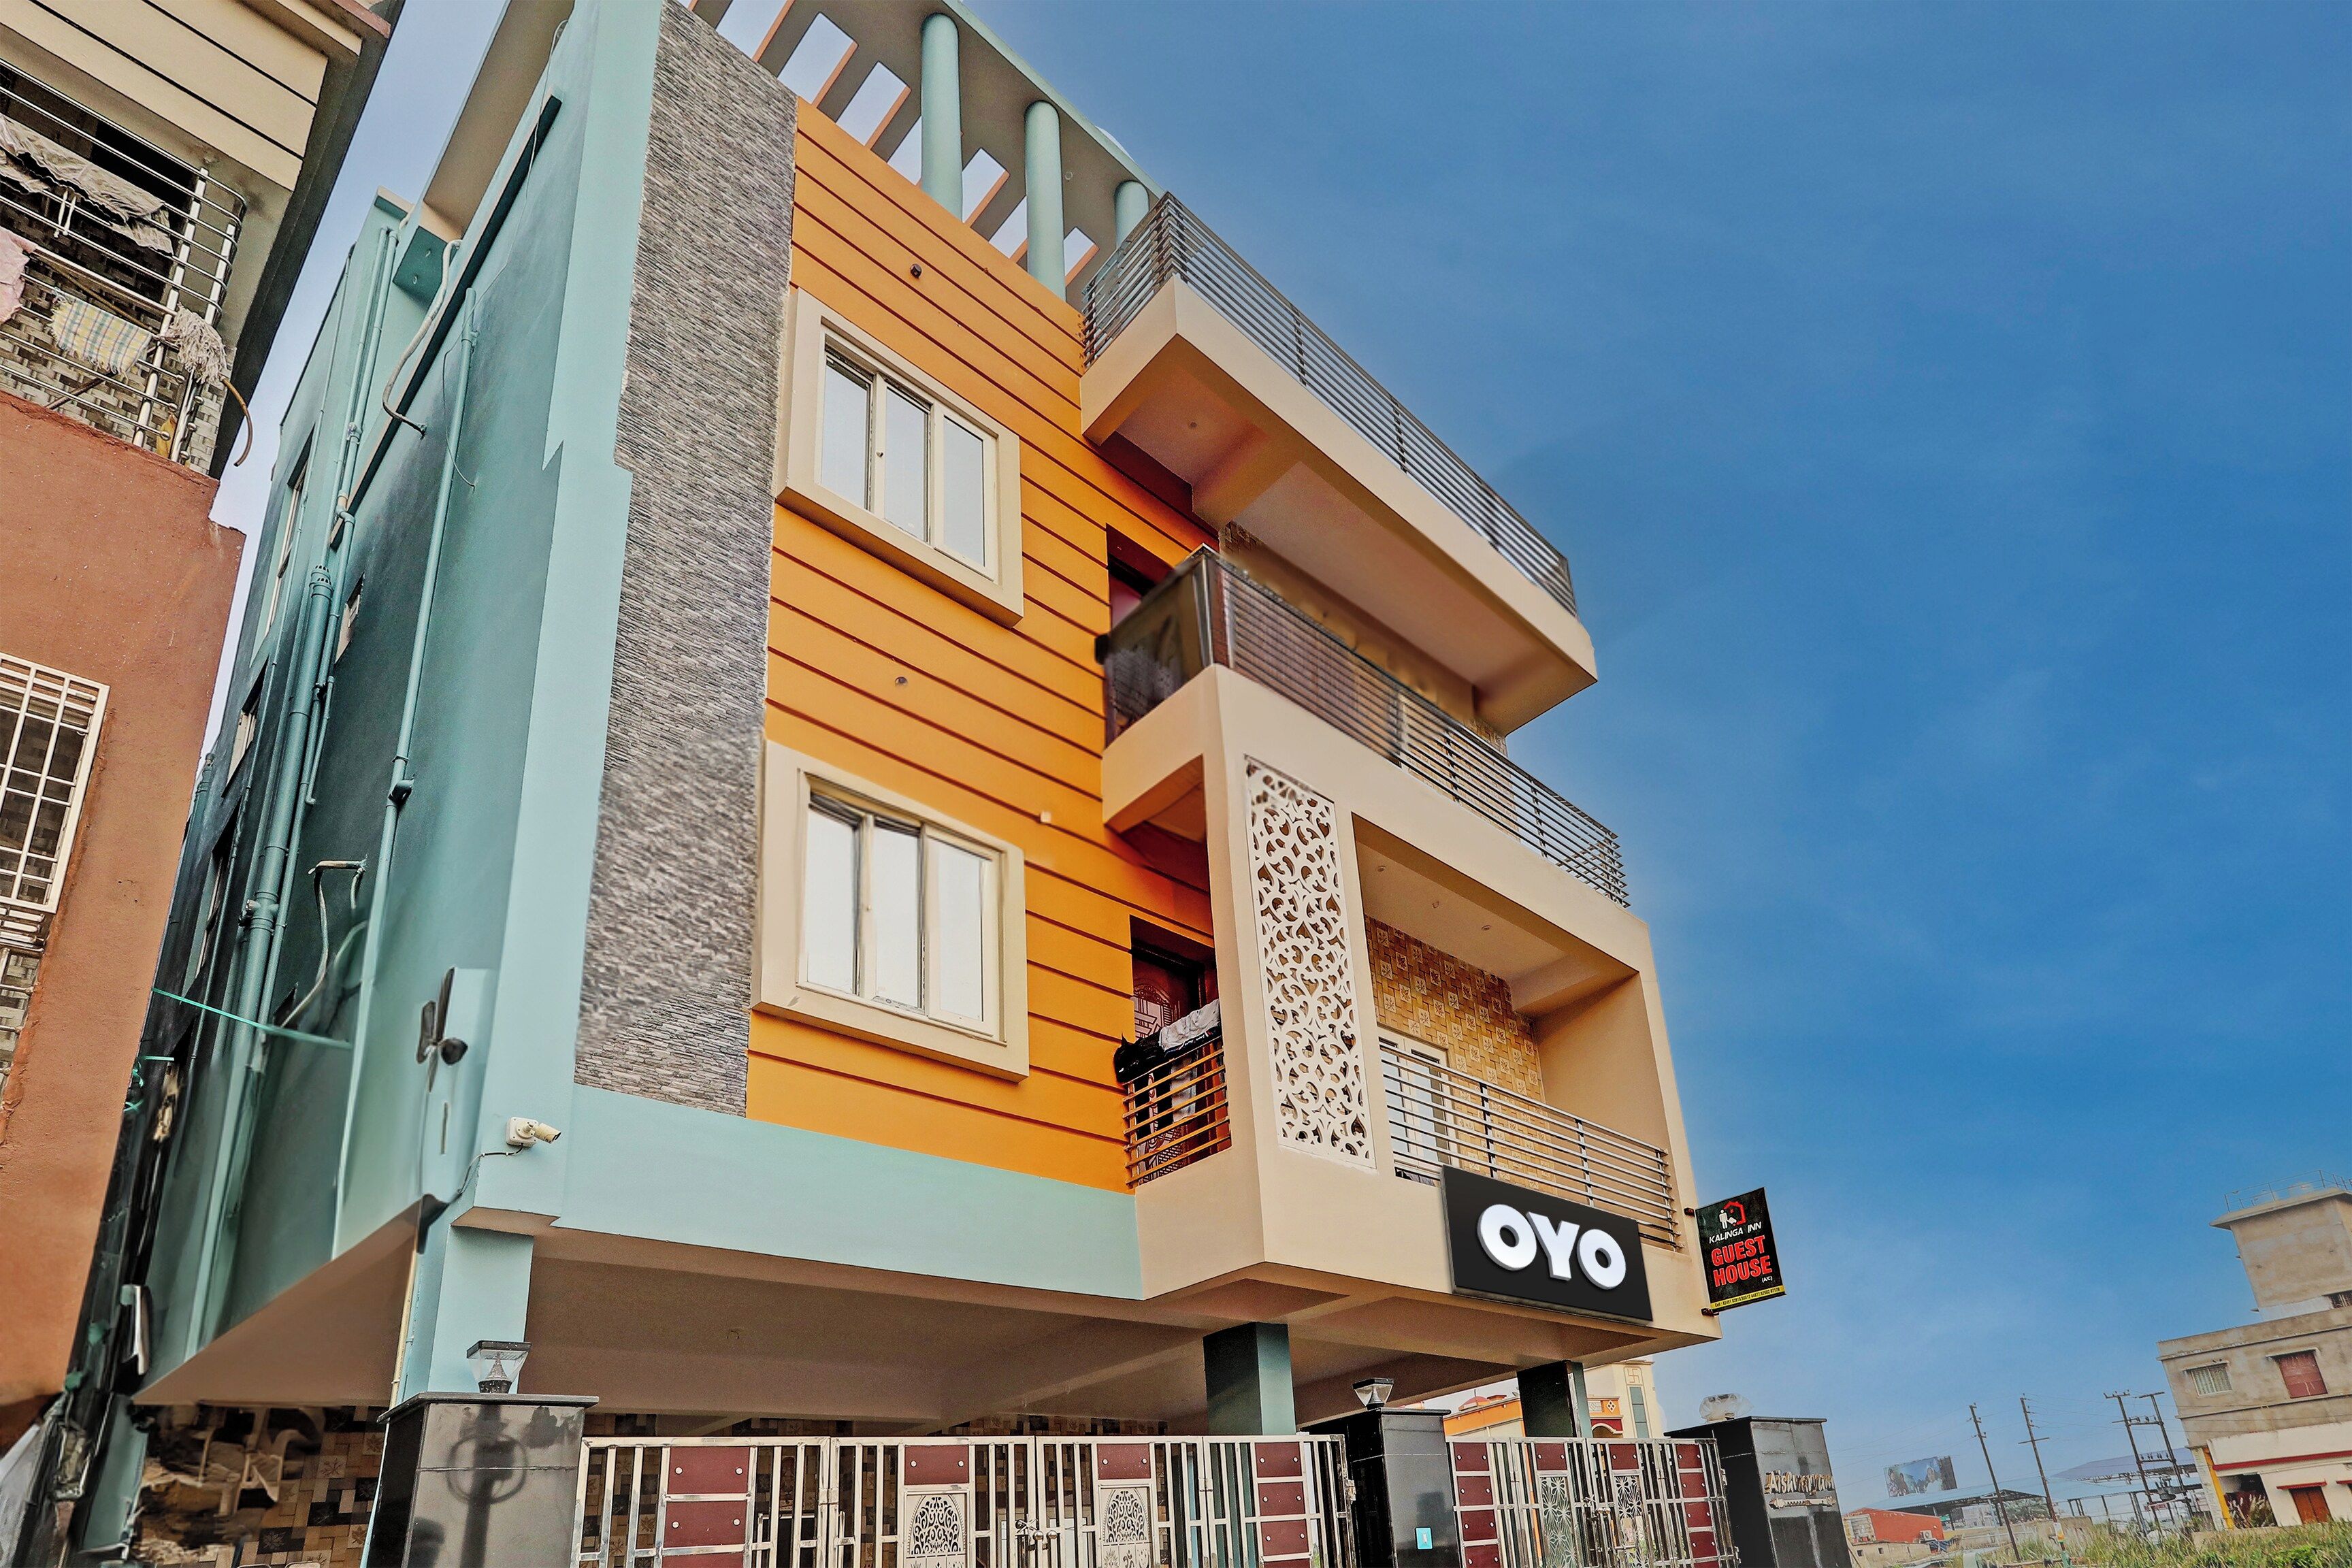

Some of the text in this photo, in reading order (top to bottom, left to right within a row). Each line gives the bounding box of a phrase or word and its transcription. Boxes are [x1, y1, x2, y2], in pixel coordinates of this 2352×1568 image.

[1477, 1204, 1626, 1290] OYO
[1709, 1221, 1762, 1244] KALINGA INN
[1711, 1235, 1765, 1267] GUEST
[1713, 1255, 1772, 1288] HOUSE
